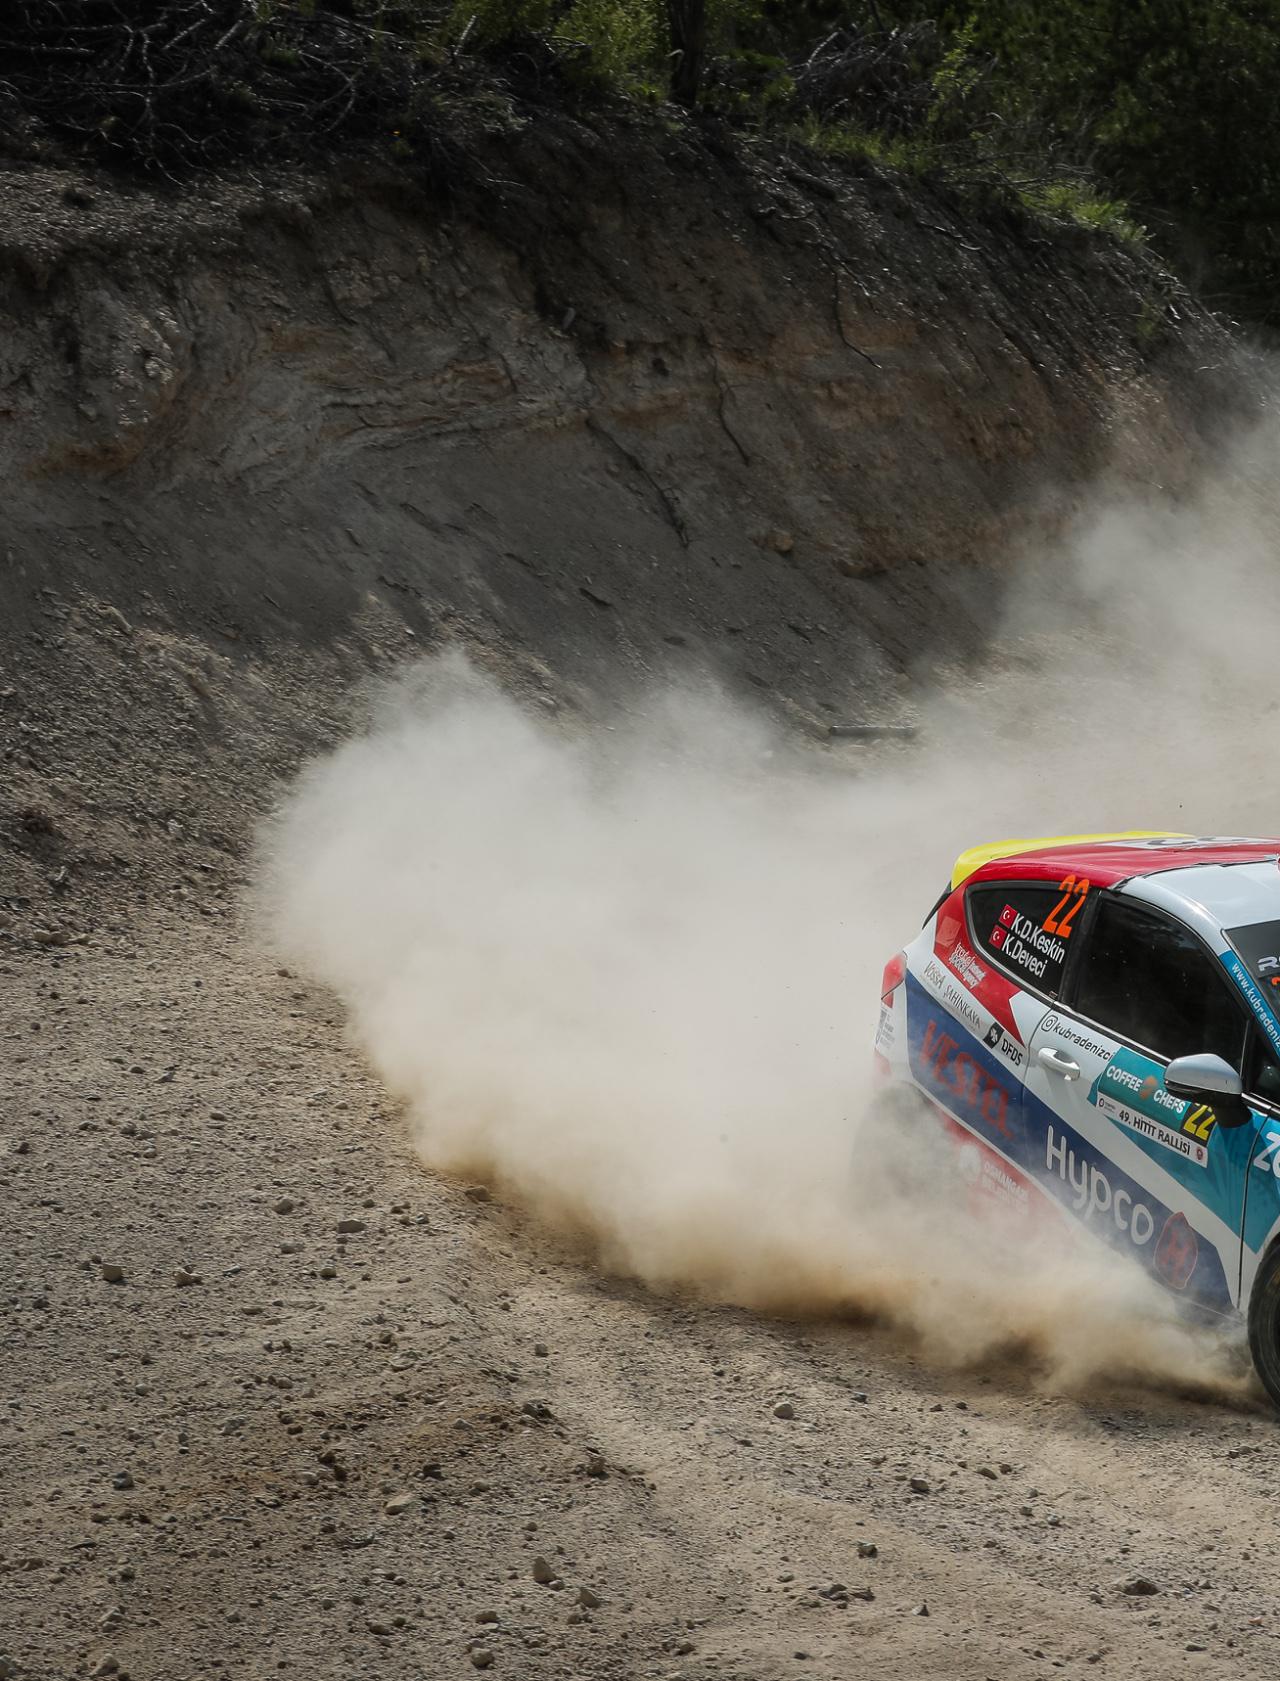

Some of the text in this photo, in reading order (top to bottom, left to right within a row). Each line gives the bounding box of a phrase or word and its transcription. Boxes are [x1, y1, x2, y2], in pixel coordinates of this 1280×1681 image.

[1042, 874, 1090, 939] 22
[1002, 935, 1048, 978] K.Deveci
[1011, 913, 1065, 964] K.D.Keskin
[1001, 1038, 1023, 1067] DFDS
[1106, 1065, 1187, 1114] COFFEE CHEFS
[1119, 1110, 1191, 1156] 49. HİTİT RALLİSİ
[1046, 1125, 1154, 1245] Hypco
